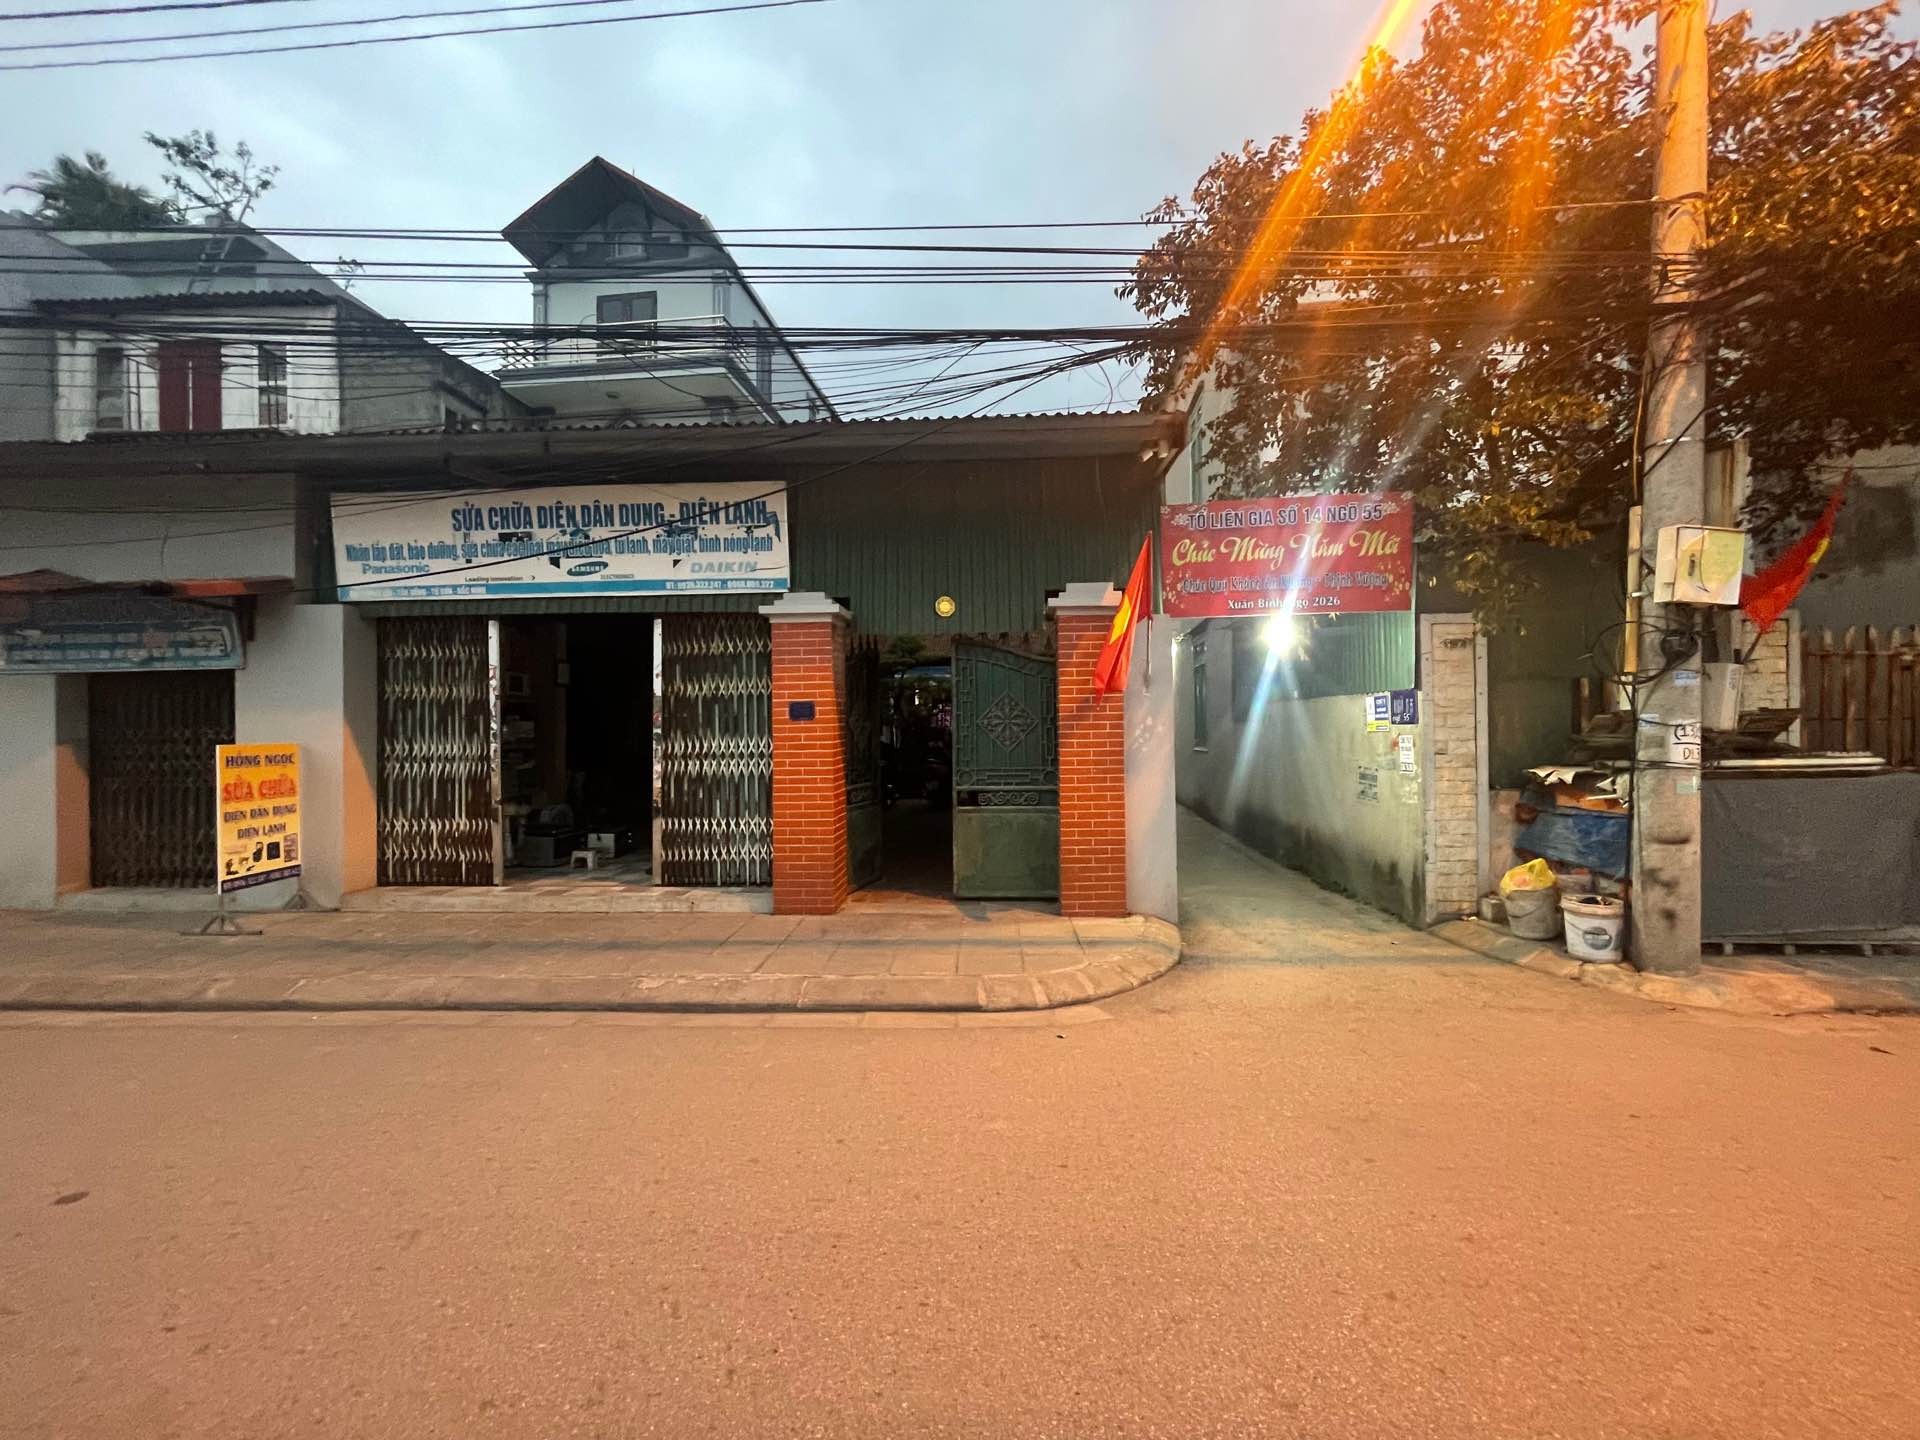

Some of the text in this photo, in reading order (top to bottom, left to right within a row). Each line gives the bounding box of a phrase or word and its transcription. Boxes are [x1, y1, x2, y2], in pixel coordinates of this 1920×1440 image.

[451, 501, 485, 531] SỬA
[489, 500, 533, 530] CHỮA
[580, 499, 615, 528] DÂN
[1188, 502, 1383, 529] TỔ LIÊN GIA SỐ 14 NGÕ 55
[1172, 530, 1401, 571] Chúc Mừng Năm Mới
[361, 562, 430, 574] Panasonic
[690, 561, 757, 574] DAIKIN
[1228, 599, 1253, 609] Xuân
[1313, 596, 1340, 607] 2026
[1403, 712, 1411, 721] 55
